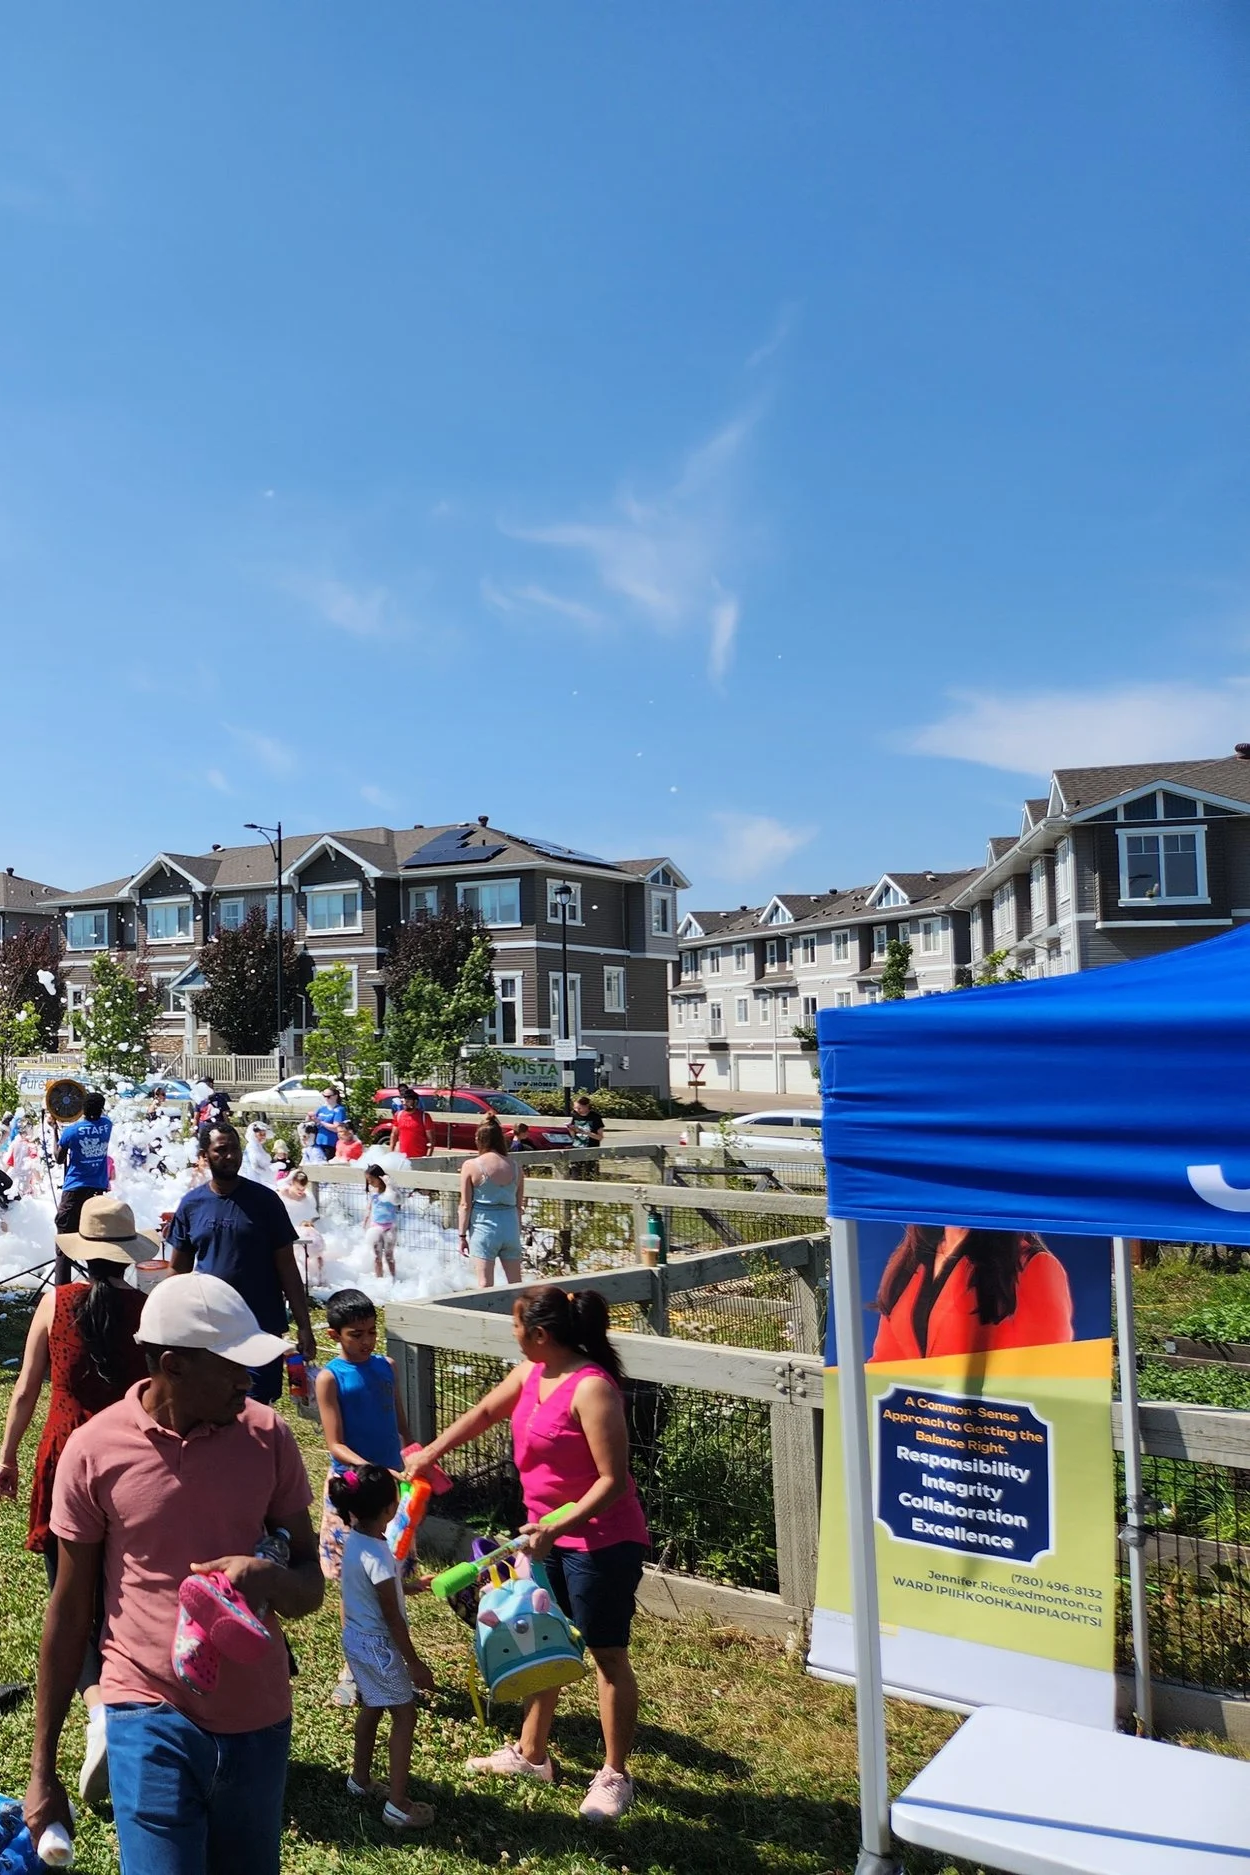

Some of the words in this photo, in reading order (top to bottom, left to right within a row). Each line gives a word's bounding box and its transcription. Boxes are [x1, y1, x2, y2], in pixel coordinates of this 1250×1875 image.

[512, 1063, 558, 1076] VISTA
[78, 1124, 108, 1135] STAFF
[904, 1396, 915, 1406] A
[917, 1397, 1019, 1423] Common-Sense
[882, 1409, 945, 1429] Approach
[946, 1420, 961, 1432] to
[962, 1423, 1017, 1442] Getting
[1018, 1430, 1044, 1444] the
[915, 1430, 965, 1449] Balance
[967, 1440, 1009, 1456] Right.
[896, 1445, 1031, 1484] Responsibility
[921, 1473, 1003, 1502] Integrity
[898, 1492, 1028, 1528] Collaboration
[911, 1517, 1014, 1550] Excellence
[892, 1576, 934, 1593] WARD
[936, 1585, 1103, 1628] IPIIHKOOHKANIPIAOHTSI
[927, 1570, 1103, 1613] Jennifer.Rice@edmonton.ca
[1011, 1573, 1043, 1589] (780)
[1046, 1580, 1103, 1600] 496-8132
